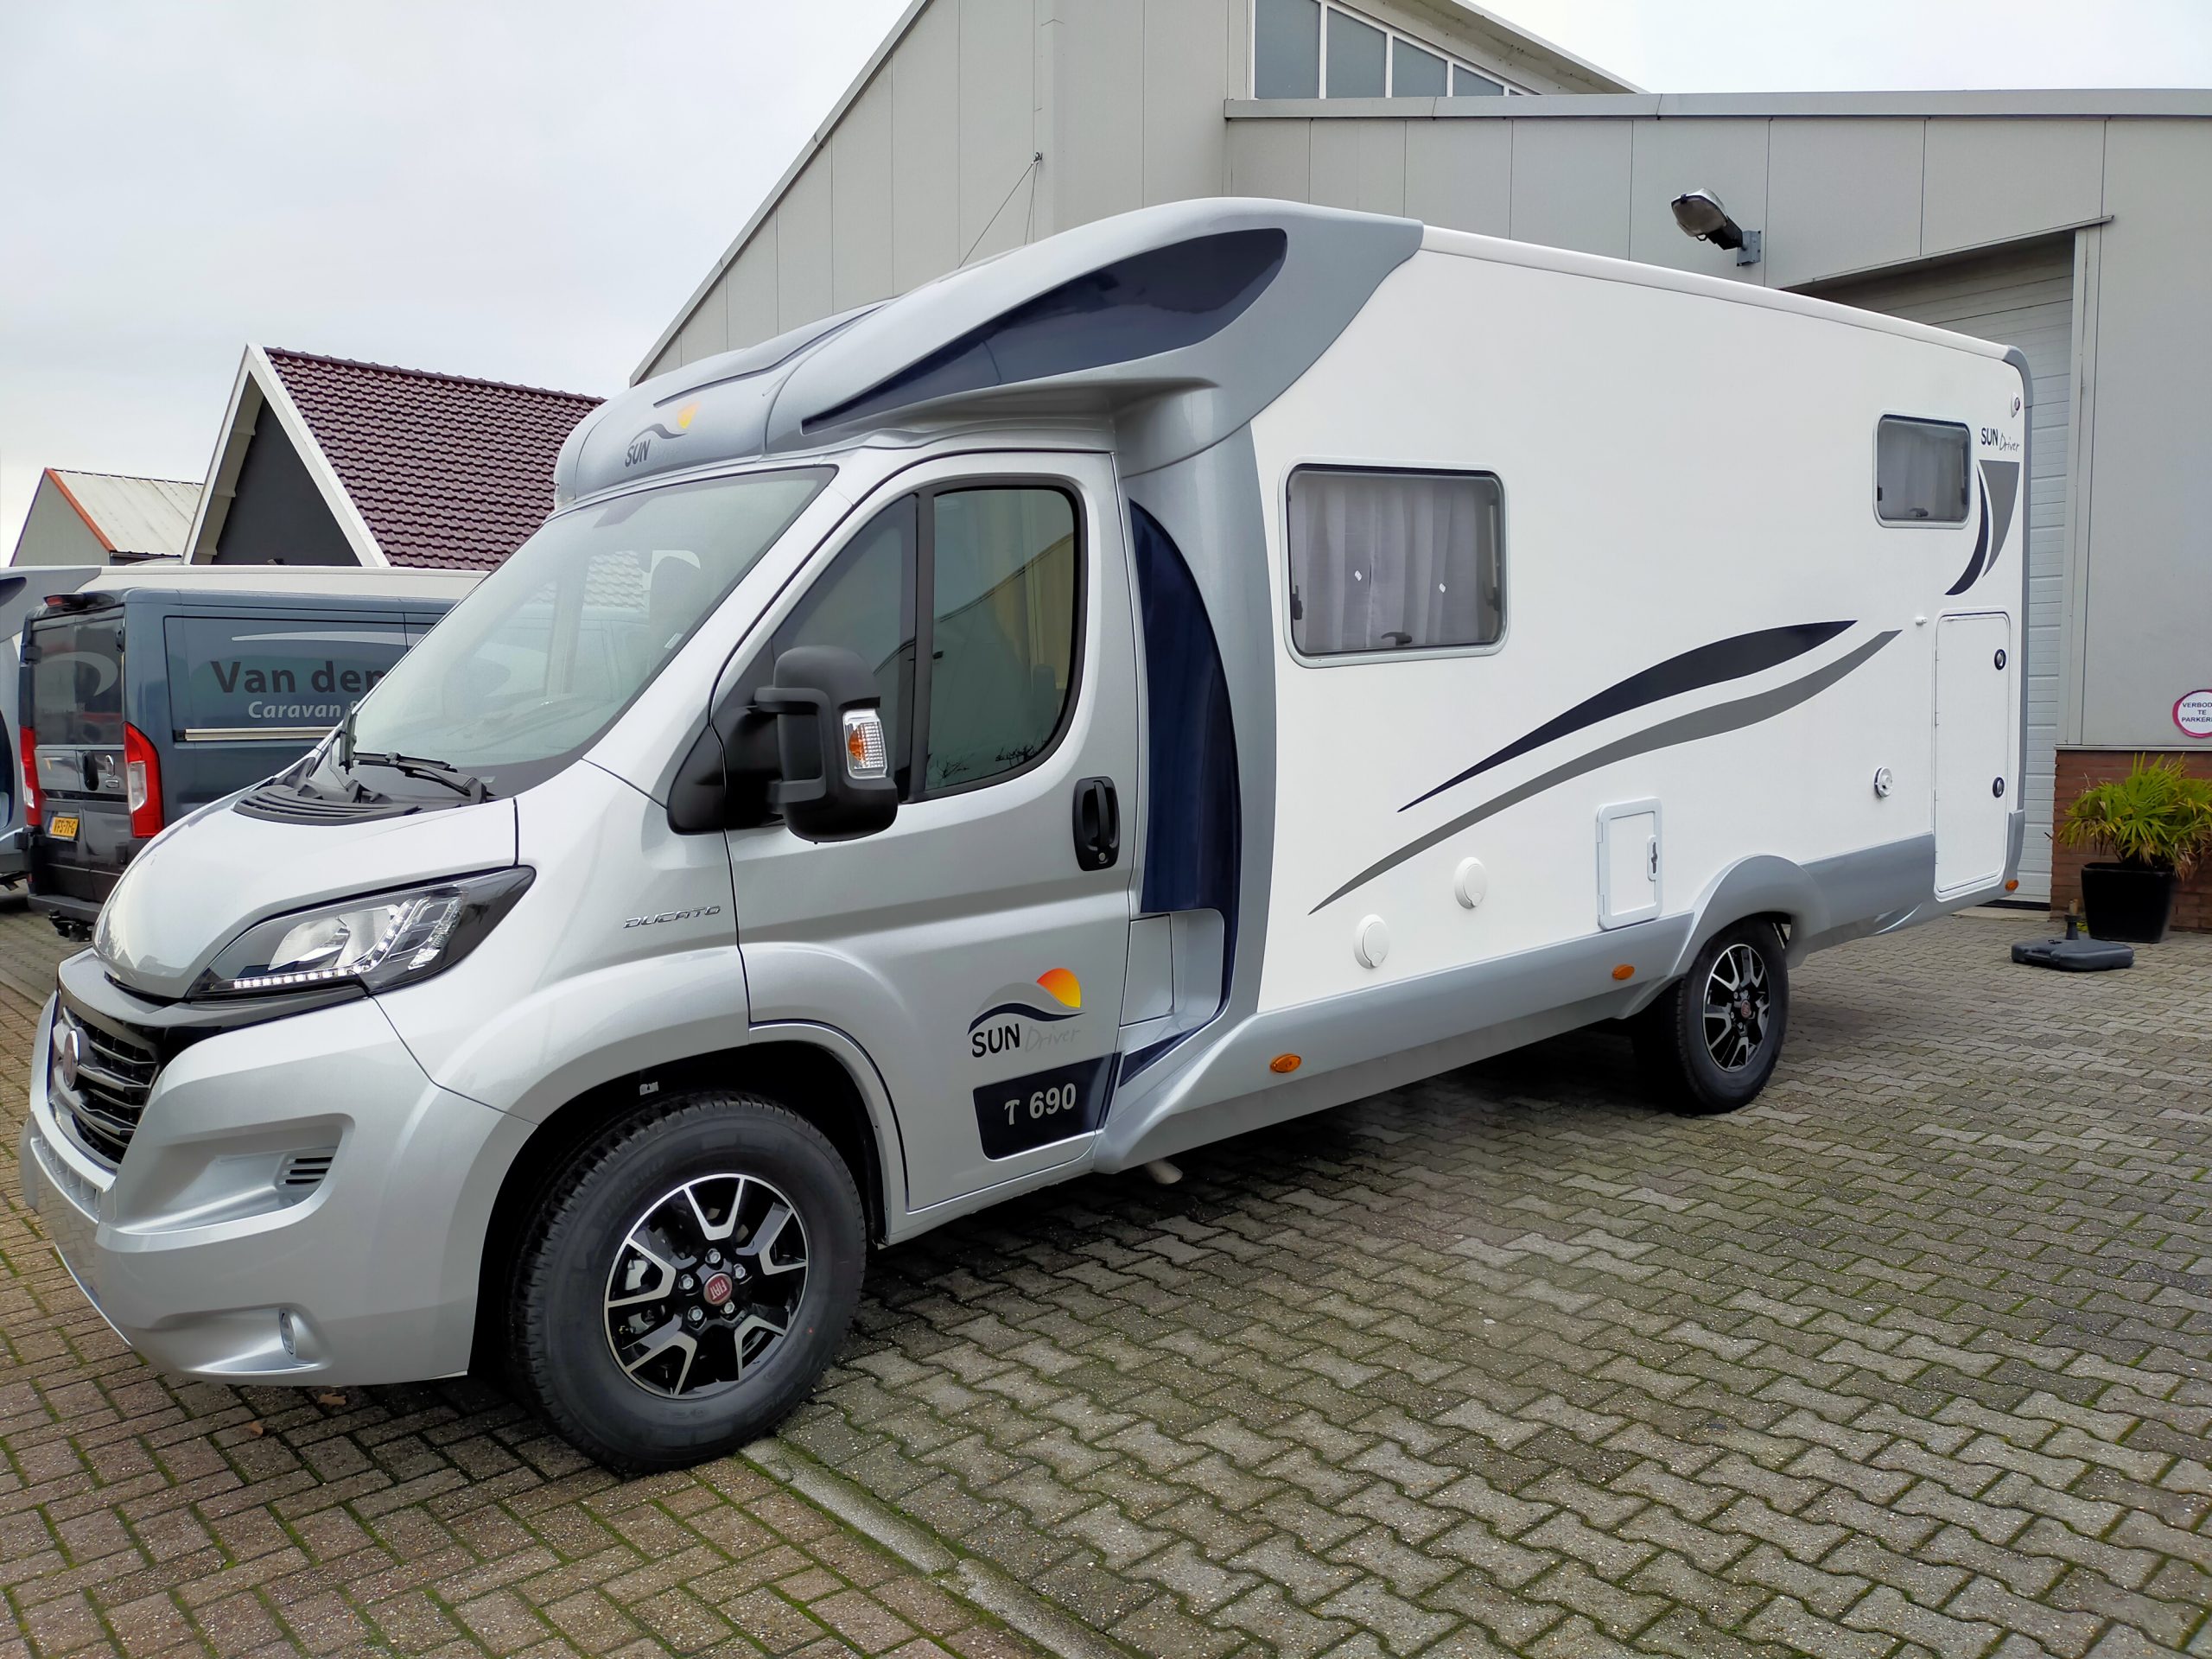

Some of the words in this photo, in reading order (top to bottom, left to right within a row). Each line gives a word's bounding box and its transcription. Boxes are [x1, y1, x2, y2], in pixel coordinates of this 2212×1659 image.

[625, 438, 652, 467] SUN
[1981, 427, 1999, 446] SUN
[1999, 432, 2020, 452] Driver
[210, 660, 296, 693] Van
[248, 701, 341, 719] Caravan
[623, 906, 721, 929] DUCATO
[971, 1023, 1020, 1058] SUN
[1025, 1026, 1081, 1053] Driver
[1004, 1099, 1020, 1126] T
[1029, 1083, 1077, 1119] 690
[709, 1279, 728, 1300] FIAT
